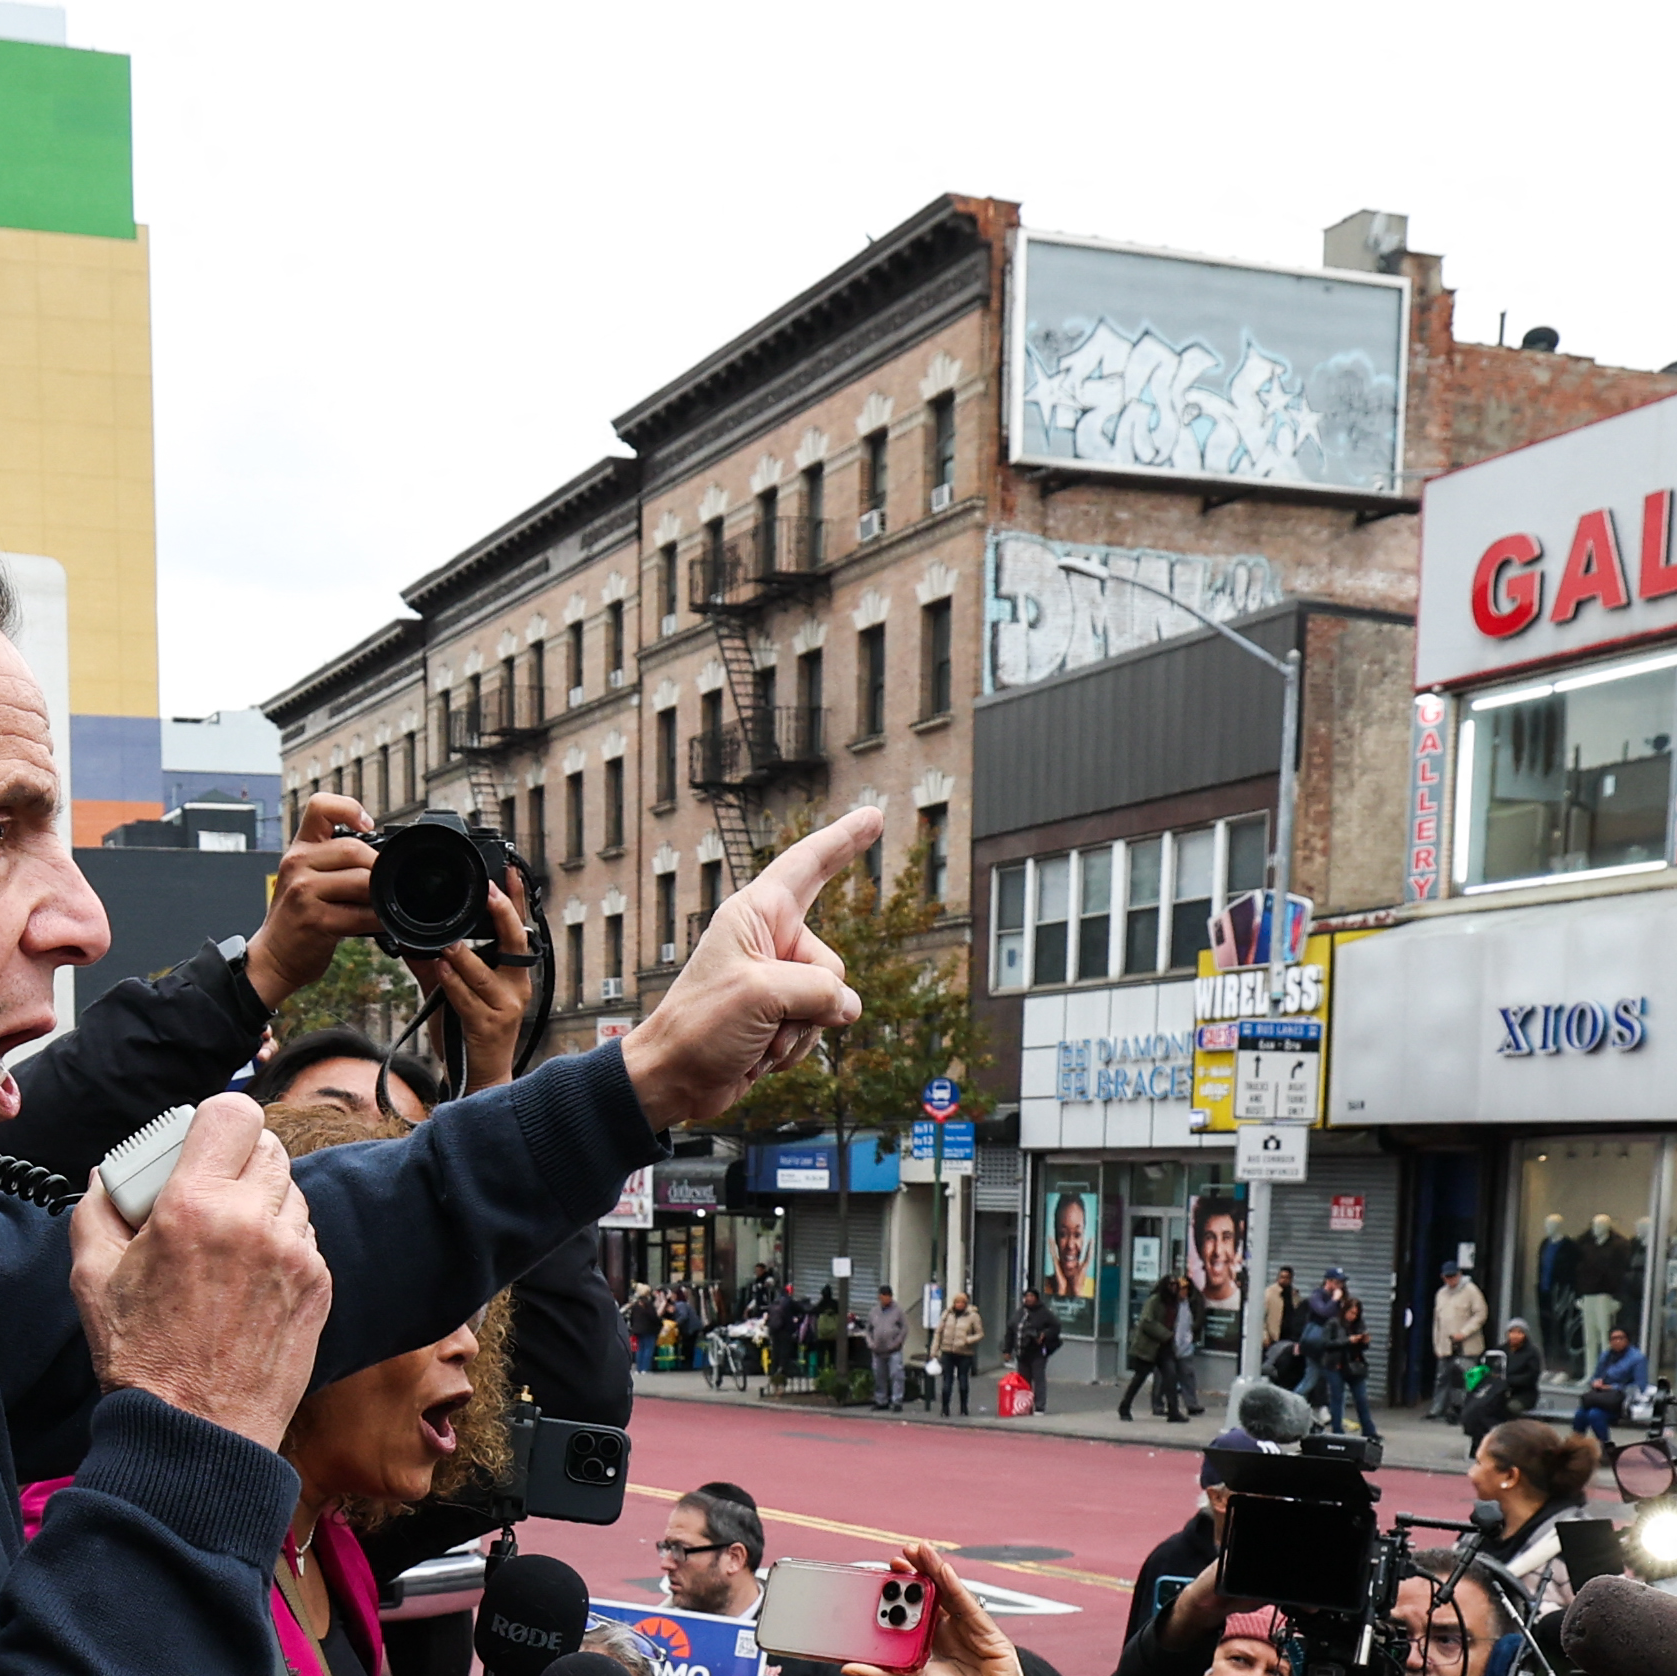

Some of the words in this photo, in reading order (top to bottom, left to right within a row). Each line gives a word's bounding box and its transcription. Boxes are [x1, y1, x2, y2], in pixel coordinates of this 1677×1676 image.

[1407, 697, 1444, 901] GALLERY
[1195, 963, 1323, 1020] WIRELSS
[1497, 996, 1648, 1057] XIOS
